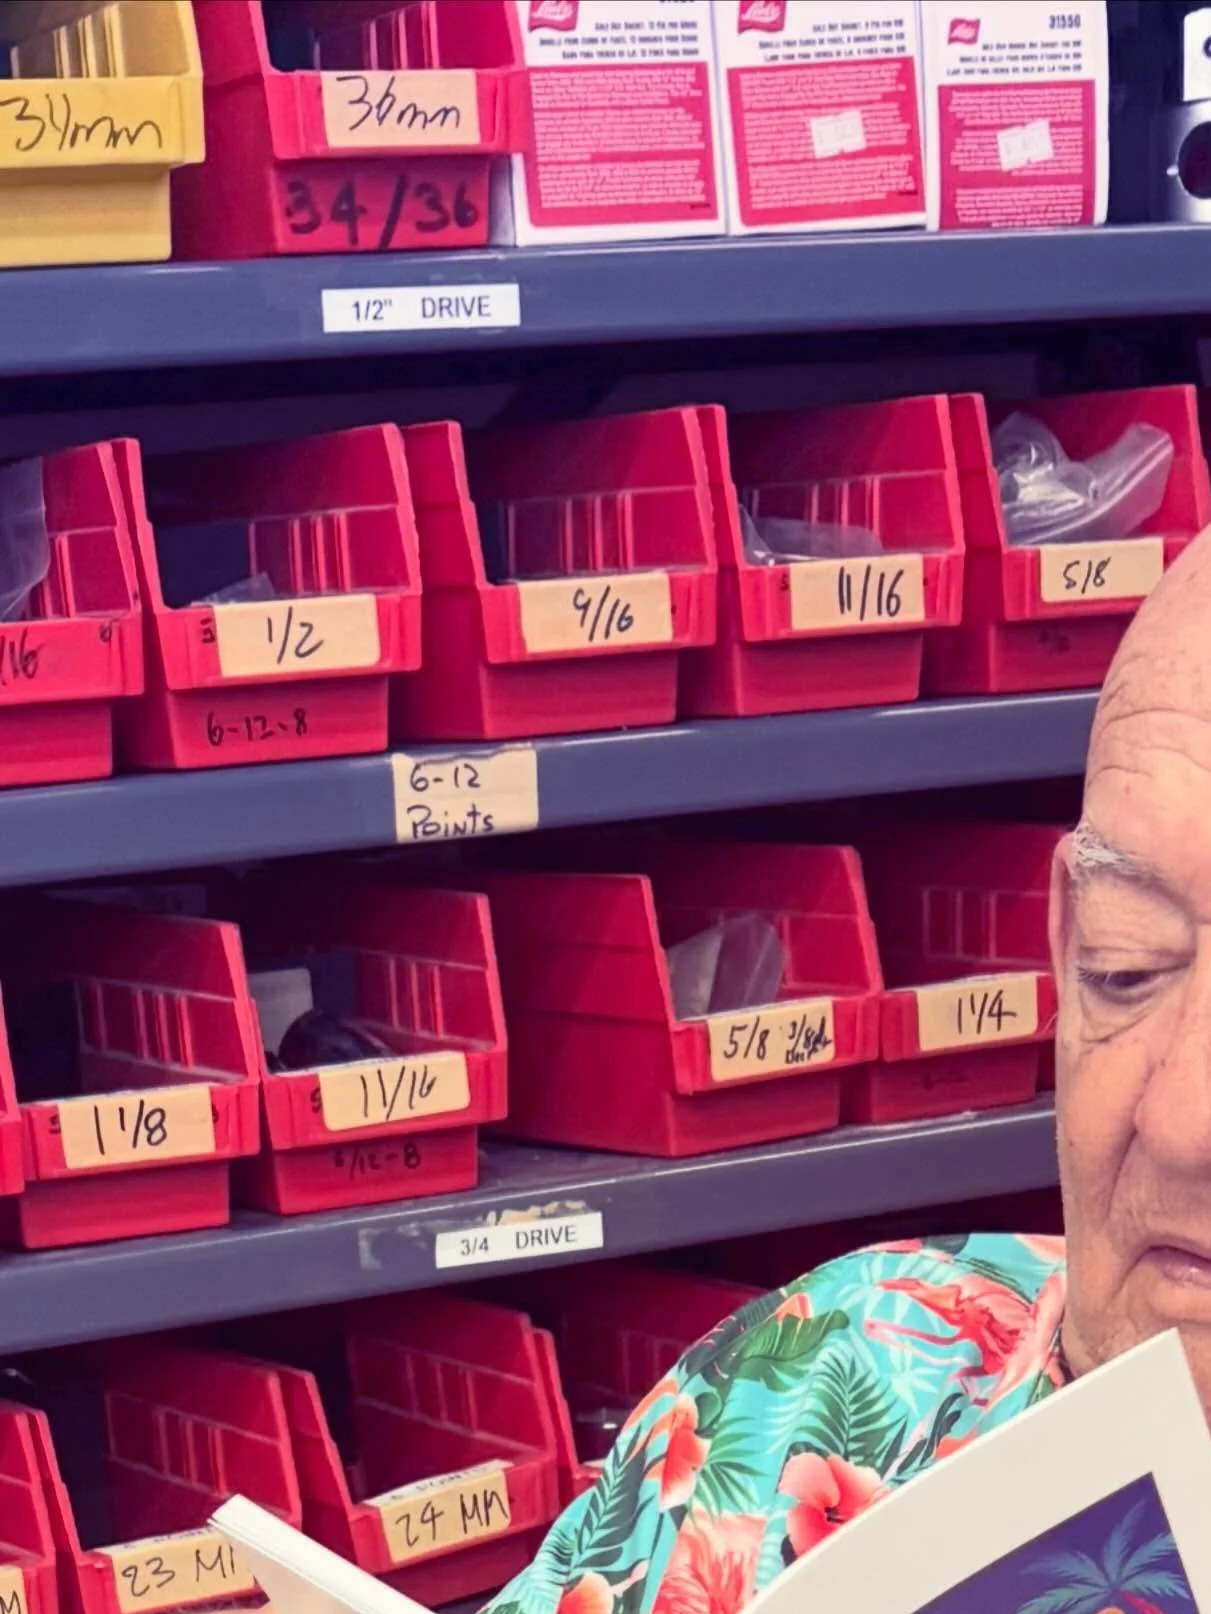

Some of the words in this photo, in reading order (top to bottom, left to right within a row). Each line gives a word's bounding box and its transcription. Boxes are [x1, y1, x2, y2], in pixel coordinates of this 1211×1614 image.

[352, 298, 393, 322] 1/2"
[421, 295, 492, 319] DRIVE
[838, 563, 904, 622] 11/16
[1063, 556, 1112, 594] 5/8
[267, 606, 325, 664] 1/2
[572, 584, 634, 642] 9/16
[410, 763, 481, 792] 6-12
[723, 1015, 770, 1061] 5/8
[459, 1237, 489, 1257] 3/4
[515, 1224, 577, 1250] DRIVE
[395, 1500, 445, 1548] 24
[460, 1489, 509, 1535] MM
[121, 1557, 176, 1597] 23
[195, 1544, 235, 1582] M
